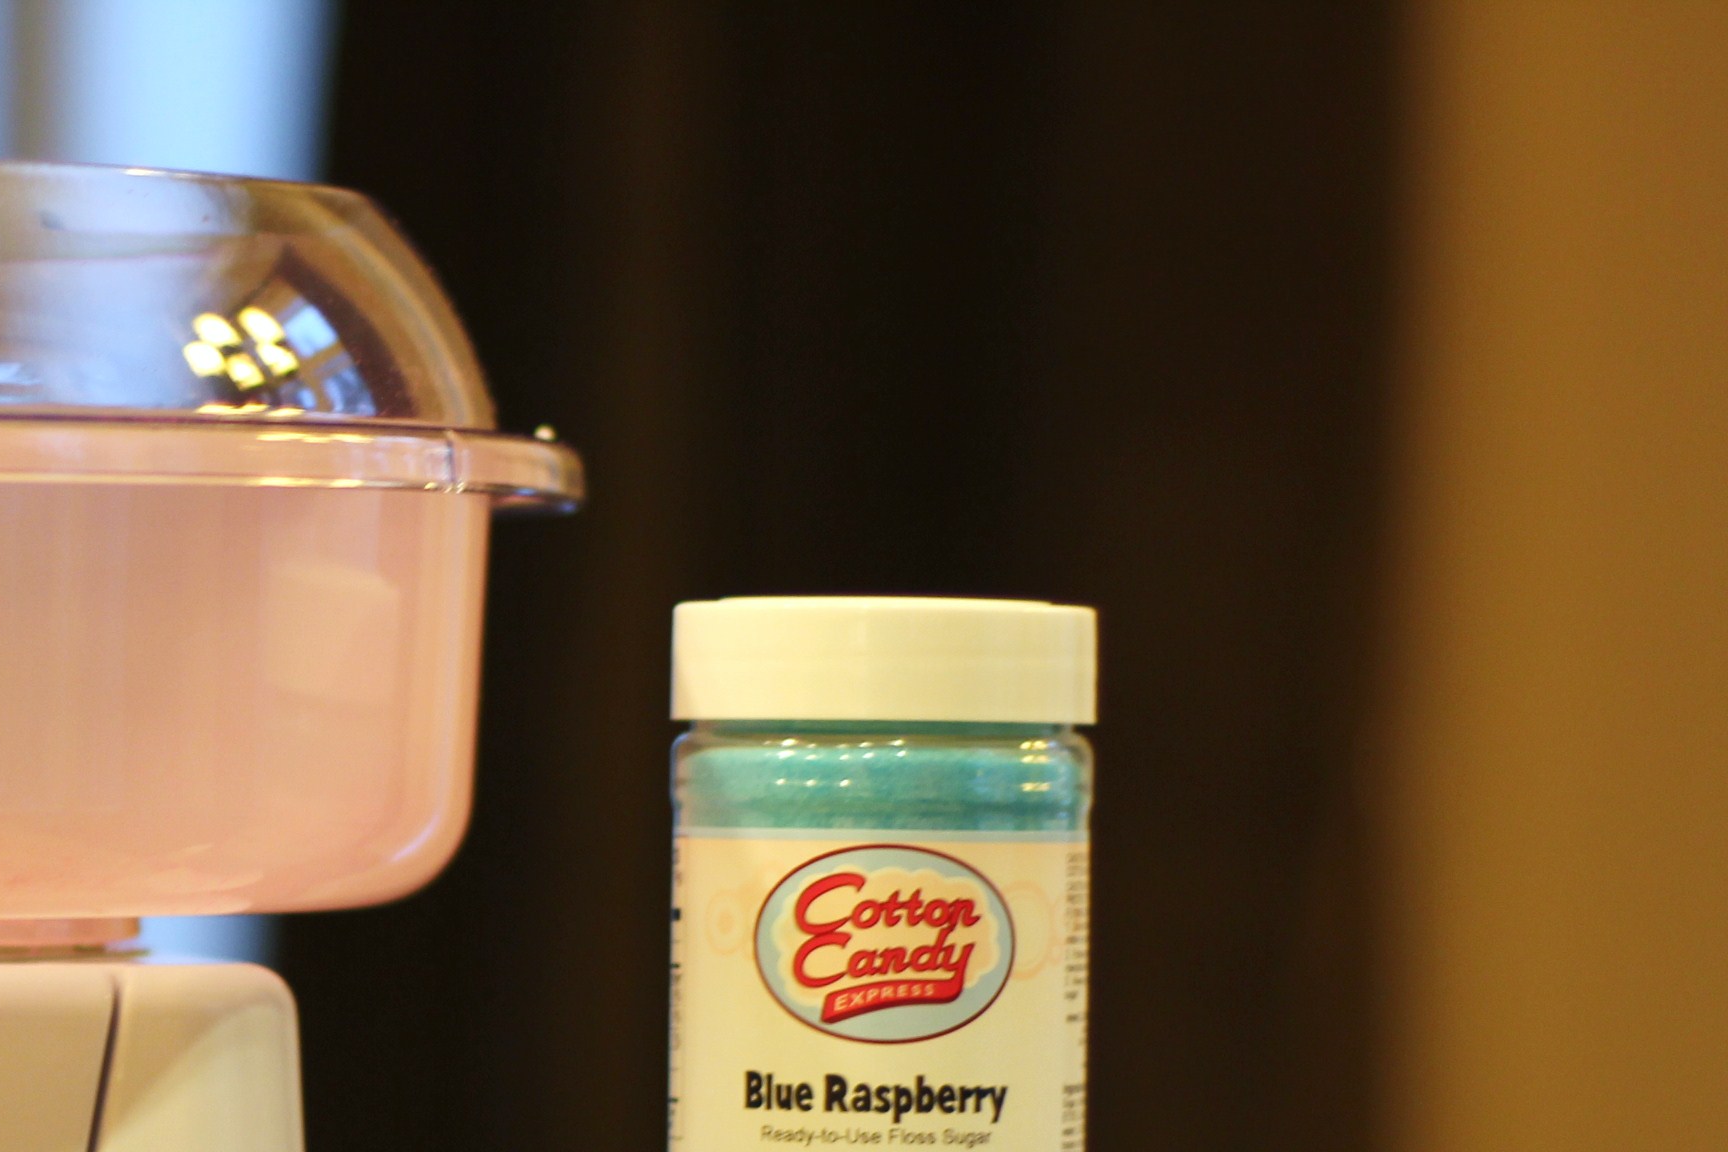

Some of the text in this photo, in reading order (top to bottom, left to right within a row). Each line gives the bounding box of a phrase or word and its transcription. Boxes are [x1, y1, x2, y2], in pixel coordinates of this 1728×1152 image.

[794, 871, 981, 936] Cotton
[792, 928, 976, 990] Candy
[832, 983, 936, 1012] EXPRESS
[743, 1070, 1008, 1125] Blue Raspberry
[760, 1124, 992, 1149] Ready-to-Use Floss Sugar
